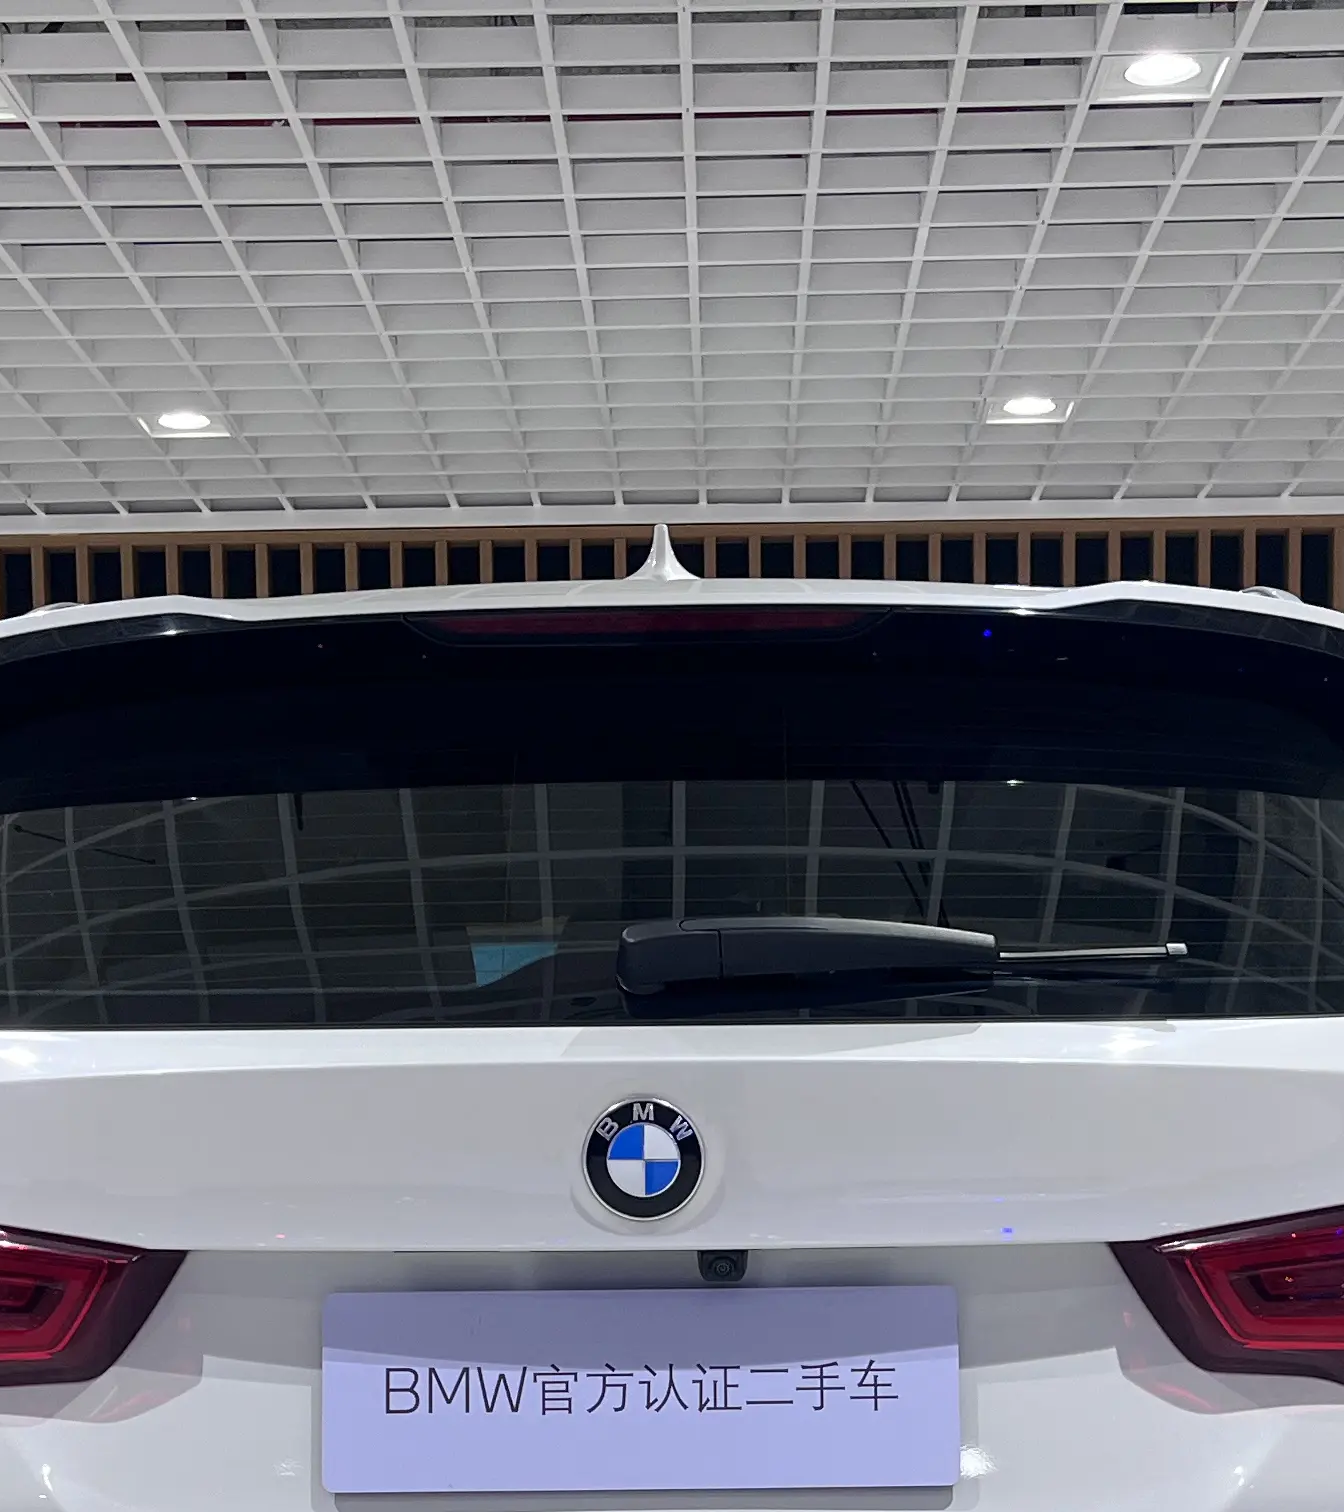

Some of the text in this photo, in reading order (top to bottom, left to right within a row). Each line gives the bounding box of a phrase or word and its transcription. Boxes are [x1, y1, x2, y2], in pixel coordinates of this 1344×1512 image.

[595, 1102, 694, 1142] BMW
[384, 1359, 900, 1416] BMW官方认证二手车
